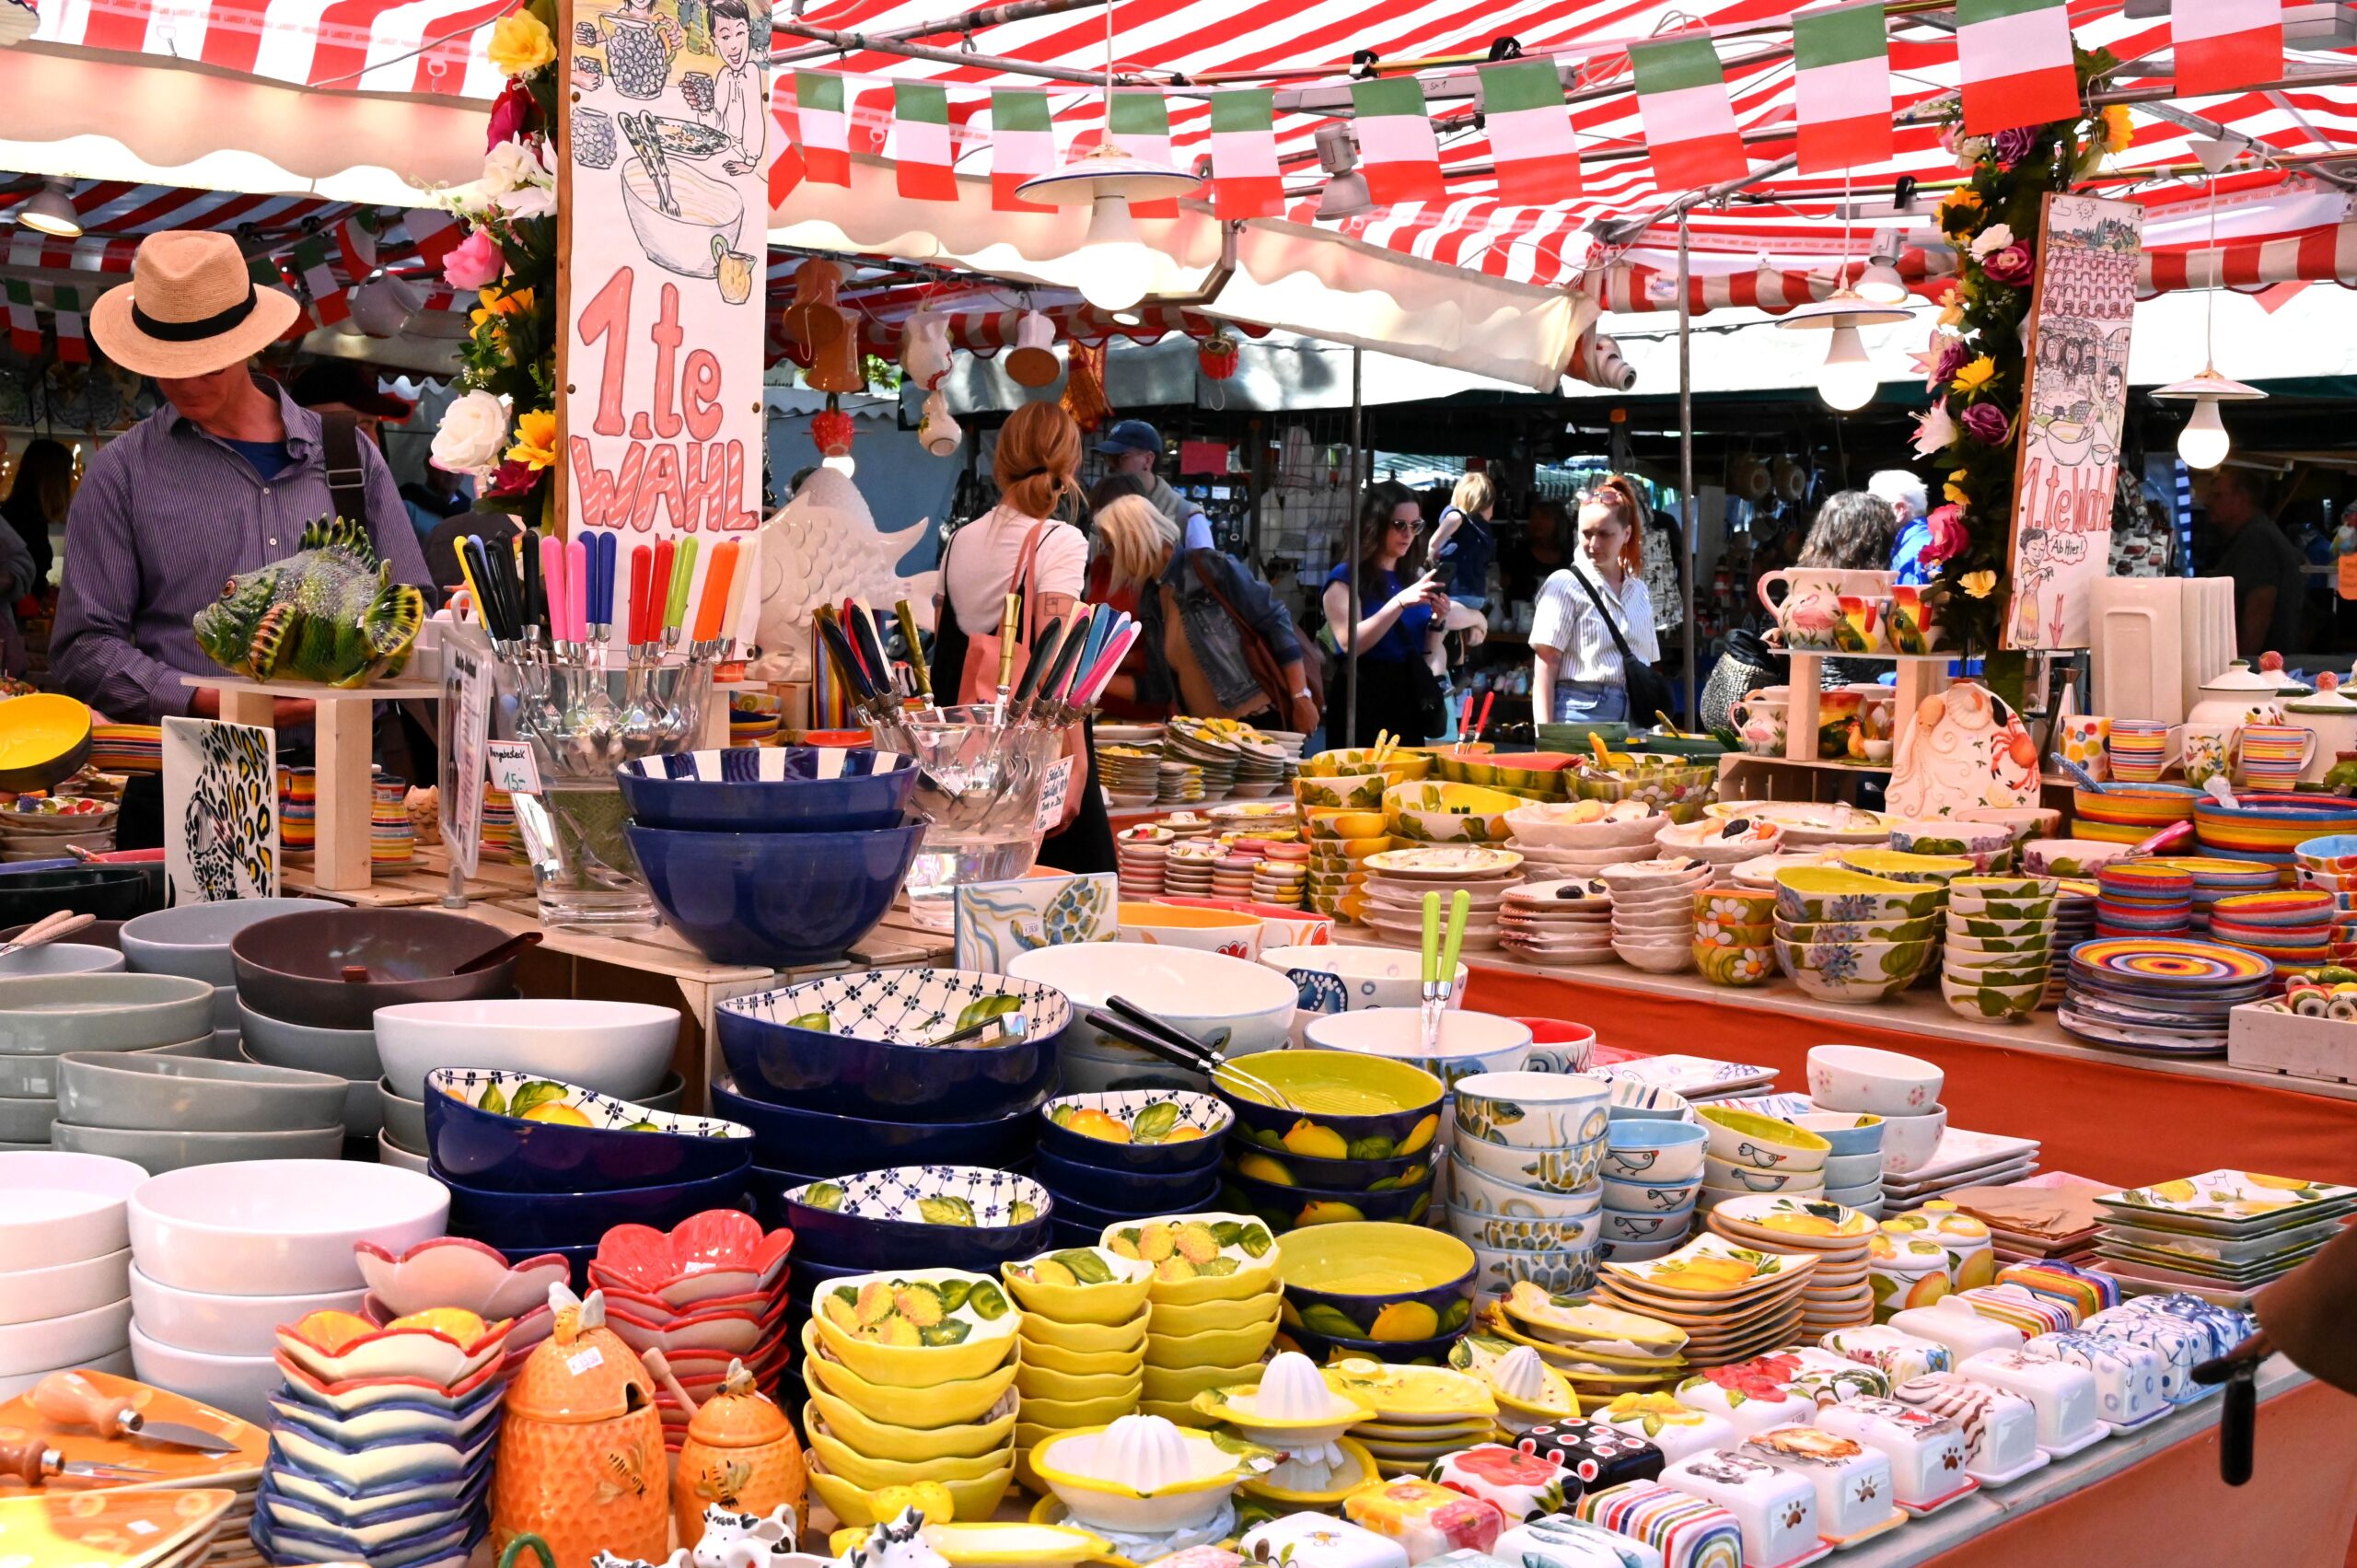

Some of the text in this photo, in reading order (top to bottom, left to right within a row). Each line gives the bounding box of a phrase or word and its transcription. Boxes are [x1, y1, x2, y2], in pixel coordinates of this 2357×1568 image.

[577, 265, 724, 441] 1.te
[570, 435, 760, 533] WAHL
[2051, 540, 2063, 554] Ab
